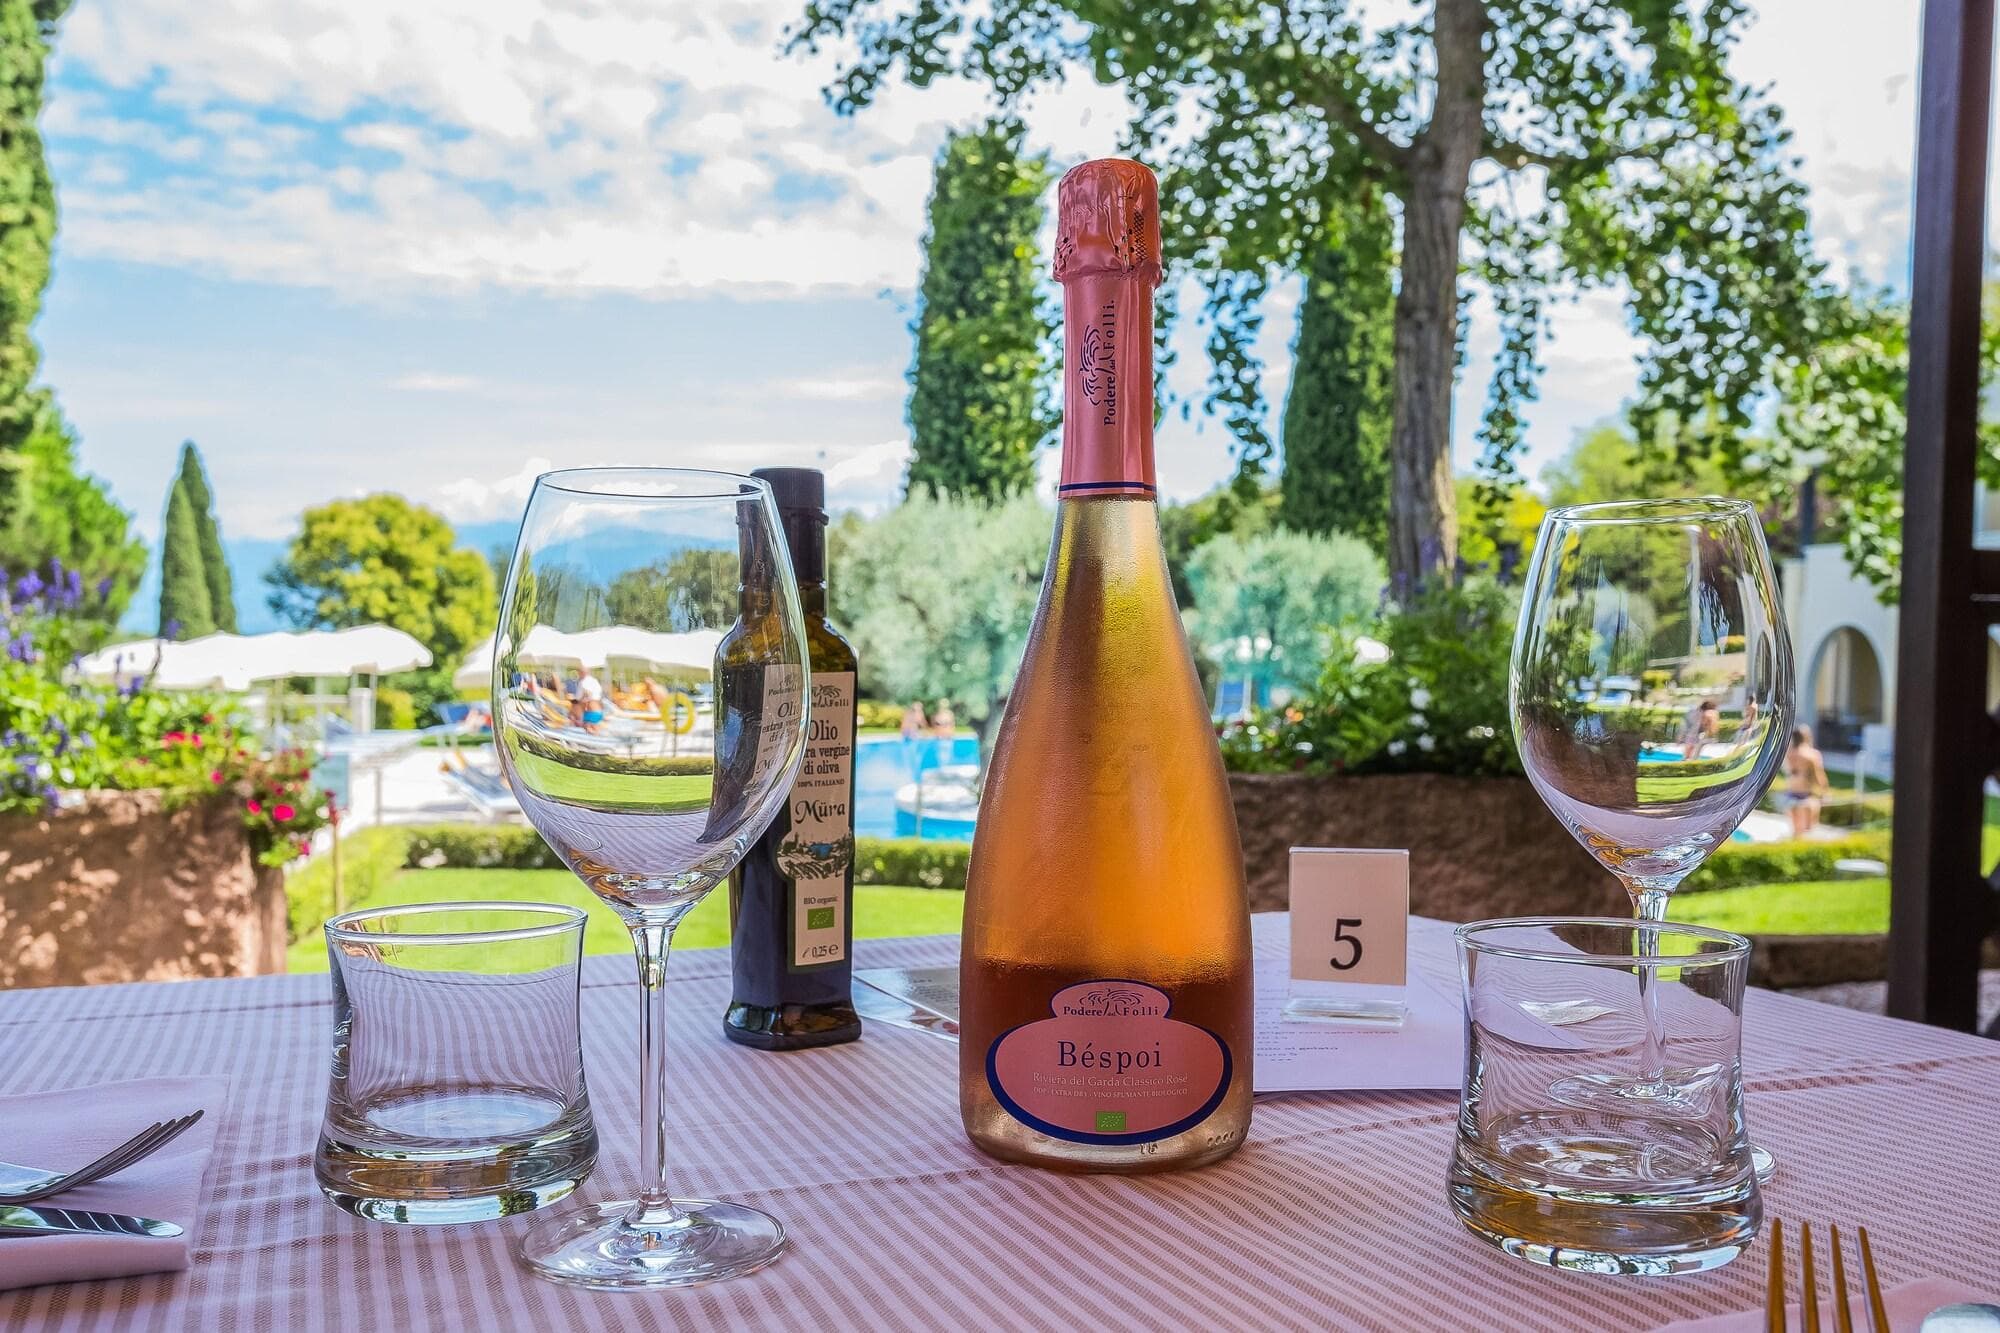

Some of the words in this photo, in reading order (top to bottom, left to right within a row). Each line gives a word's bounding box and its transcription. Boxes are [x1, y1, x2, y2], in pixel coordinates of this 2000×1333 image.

[1103, 377, 1116, 425] Podere
[819, 743, 850, 760] vergine
[804, 761, 814, 775] di
[817, 761, 840, 775] oliva
[795, 800, 846, 825] Müra
[1330, 918, 1363, 970] 5
[1064, 1006, 1103, 1017] Podere
[1123, 1006, 1159, 1016] Folli
[1057, 1040, 1162, 1074] Béspoi
[1033, 1072, 1067, 1085] Riviera
[1069, 1075, 1085, 1086] del
[1087, 1077, 1120, 1087] Garda
[1122, 1075, 1163, 1087] Classico
